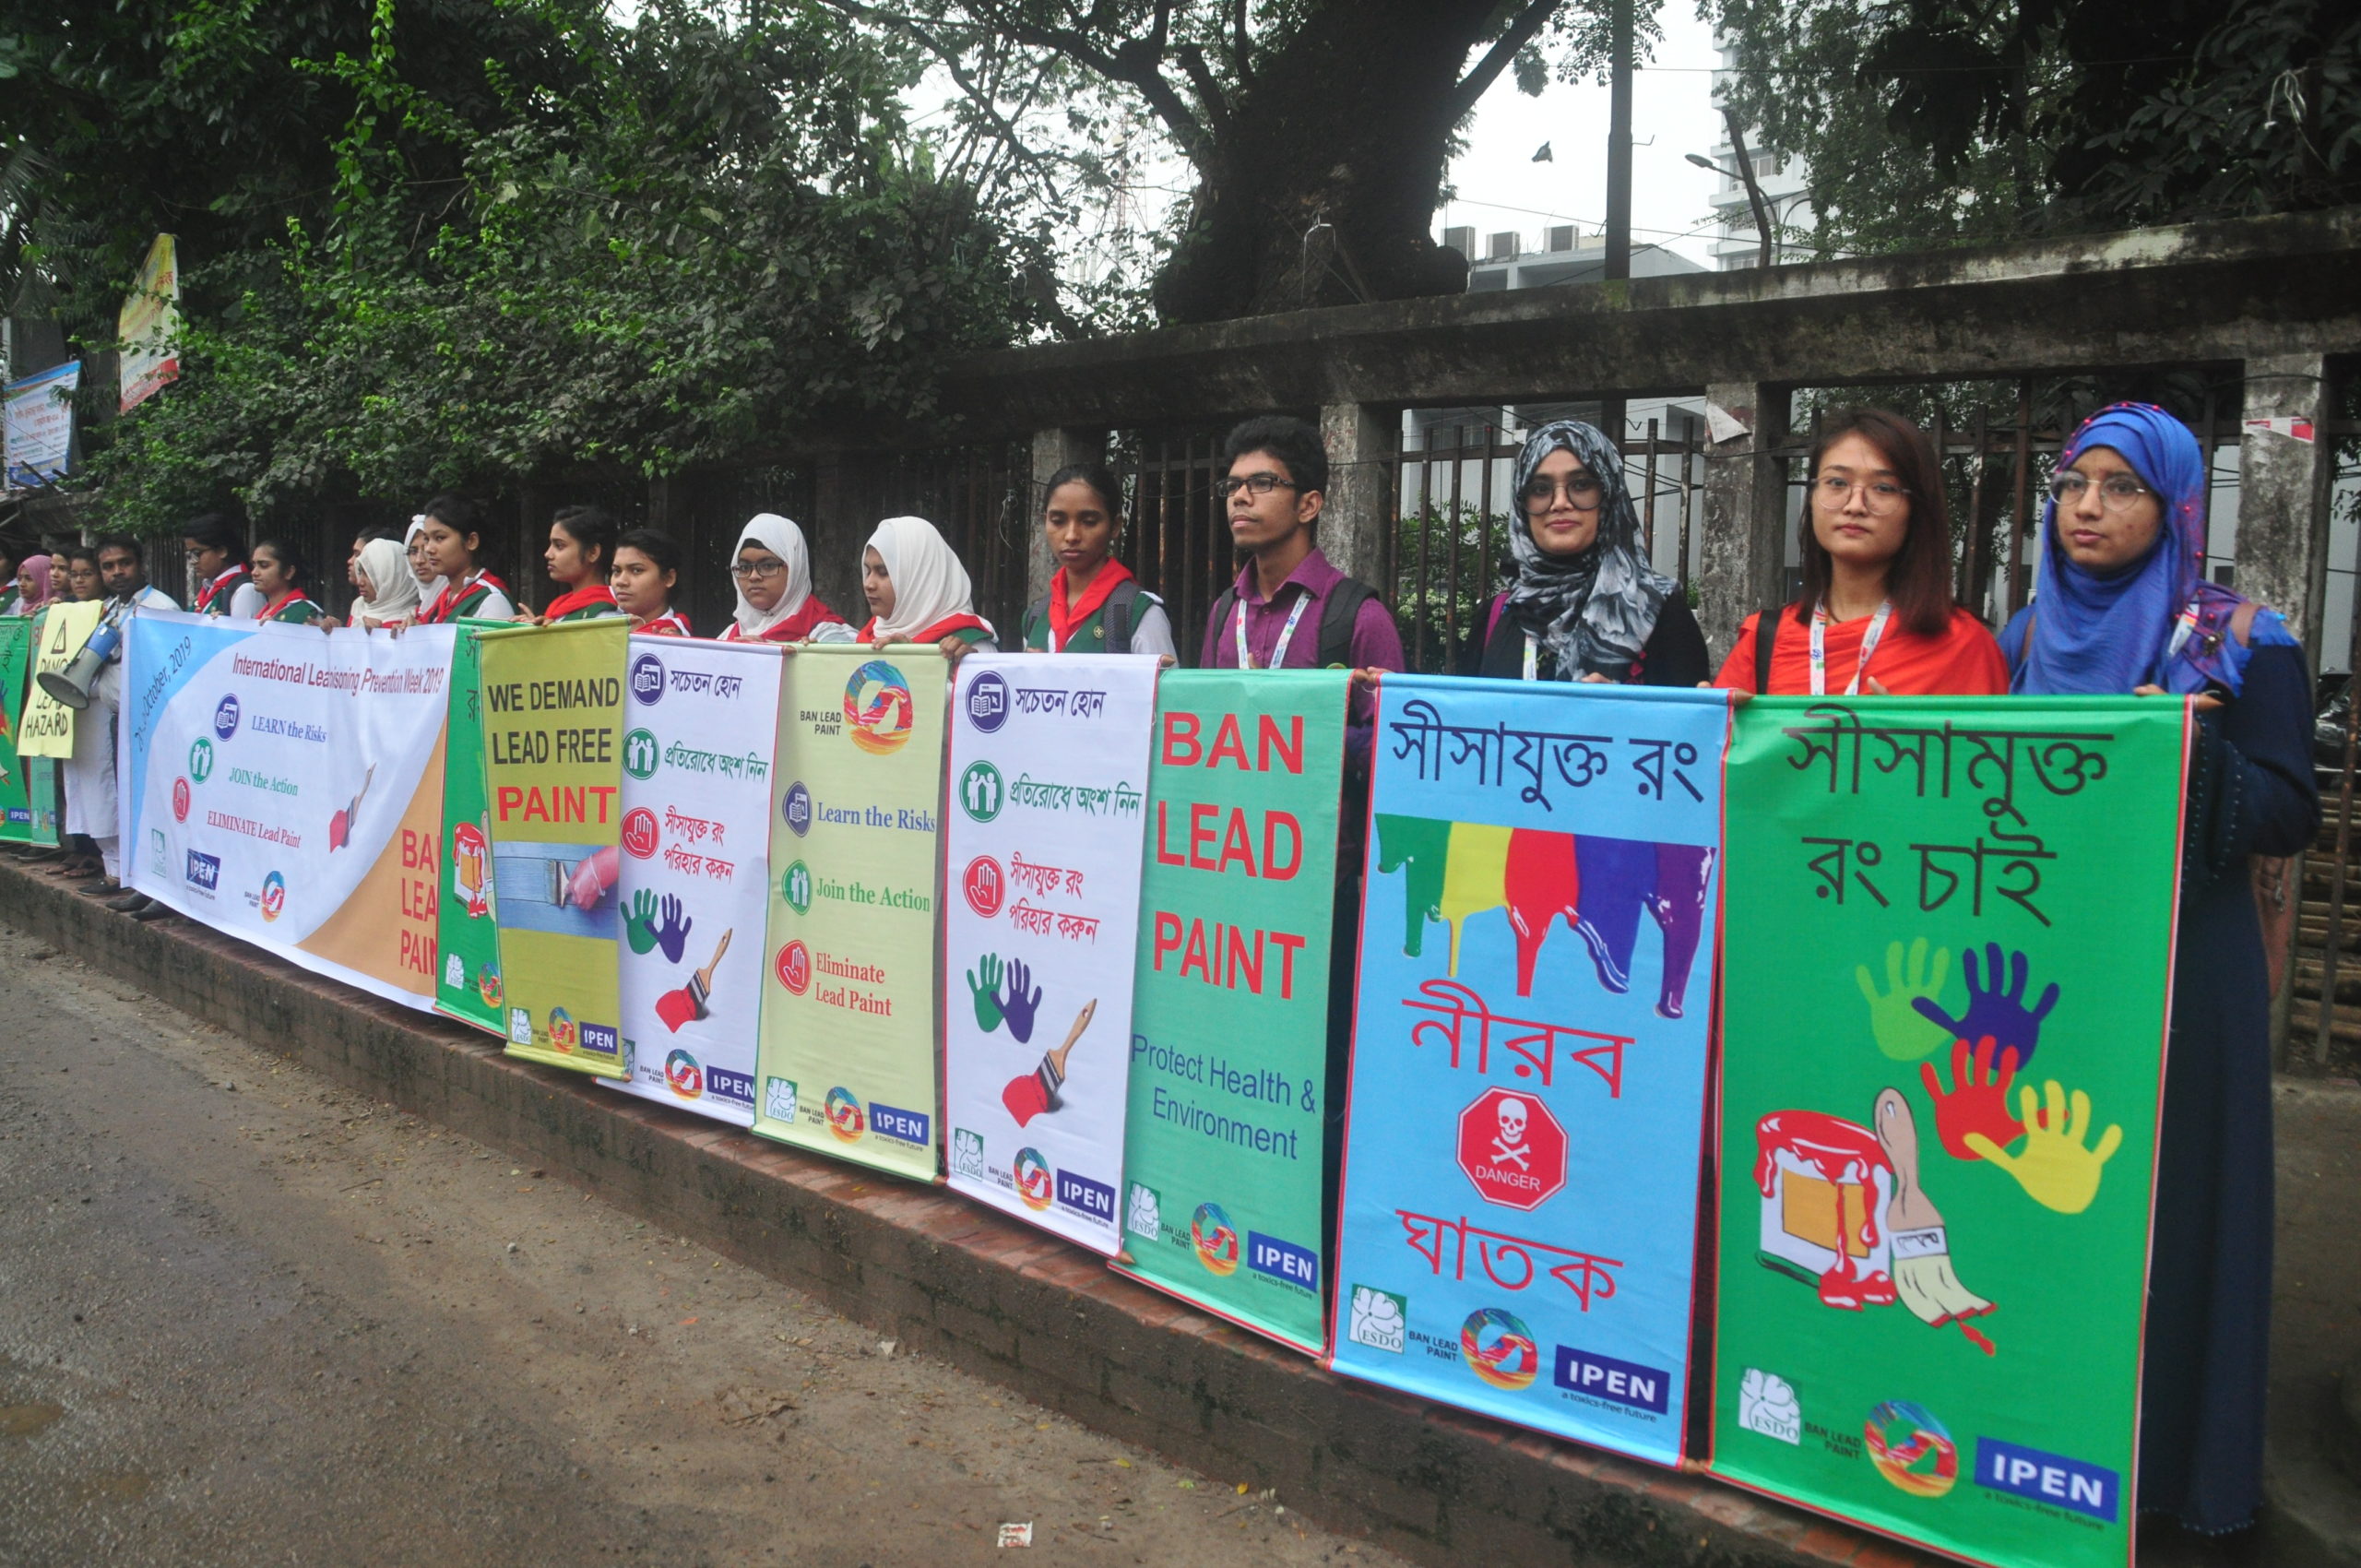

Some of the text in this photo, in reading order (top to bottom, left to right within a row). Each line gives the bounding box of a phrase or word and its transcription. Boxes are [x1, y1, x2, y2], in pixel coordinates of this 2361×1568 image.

[168, 636, 192, 674] 2019
[232, 652, 306, 685] International
[423, 667, 445, 695] 2019
[670, 671, 742, 699] সচেতন হোন
[488, 677, 620, 712] WE DEMAND
[1015, 688, 1107, 719] সচেতন হোন
[26, 712, 68, 738] HAZARD
[252, 716, 327, 742] LEARN the Risks
[801, 710, 842, 723] BAN LEAD
[814, 724, 841, 736] PAINT
[492, 728, 612, 765] LEAD FREE
[1161, 711, 1303, 775] BAN
[1390, 699, 1704, 813] সীসাযুক্ত রং
[665, 741, 769, 783] প্রতিরোধে অংশ নিন
[1782, 703, 2115, 827] সীসামুক্ত
[229, 767, 299, 796] JOIN the Action
[1009, 773, 1142, 819] প্রতিরোধে অংশ নিন
[497, 786, 617, 824] PAINT
[817, 802, 936, 833] Learn the Risks
[207, 811, 302, 849] ELIMINATE Lead Paint
[666, 805, 725, 847] সীসাযুক্ত রং
[1157, 801, 1303, 881] LEAD
[402, 829, 440, 874] BA
[664, 844, 734, 884] পরিহার করুন
[189, 856, 216, 883] IPEN
[1011, 850, 1084, 899] সীসাযুক্ত রং
[1801, 820, 2058, 927] রং চাই
[401, 878, 436, 922] LEA
[816, 878, 930, 912] Join the Action
[1009, 897, 1100, 944] পরিহার করুন
[816, 952, 885, 984] Eliminate
[1154, 910, 1305, 1000] PAINT
[815, 982, 892, 1016] Lead Paint
[584, 1029, 613, 1049] IPEN
[1402, 979, 1635, 1099] নীরব
[1132, 1033, 1315, 1114] Protect Health &
[876, 1111, 922, 1138] IPEN
[1153, 1087, 1298, 1160] Environment
[1476, 1165, 1540, 1192] DANGER
[1064, 1181, 1109, 1213] IPEN
[1134, 1220, 1158, 1238] ESDO
[1160, 1222, 1191, 1241] BAN LEAD
[1171, 1236, 1190, 1251] PAINT
[1257, 1243, 1312, 1282] IPEN
[1395, 1208, 1623, 1313] ঘাতক
[1361, 1330, 1403, 1350] ESDO
[1408, 1330, 1459, 1352] BAN LEAD
[1427, 1346, 1457, 1363] PAINT
[1568, 1360, 1656, 1403] IPEN
[1570, 1393, 1623, 1413] toxics-free
[1623, 1407, 1657, 1423] future
[1753, 1415, 1798, 1441] ESDO
[1805, 1422, 1861, 1448] BAN LEAD
[1824, 1441, 1860, 1461] PAINT
[1993, 1453, 2103, 1508] IPEN
